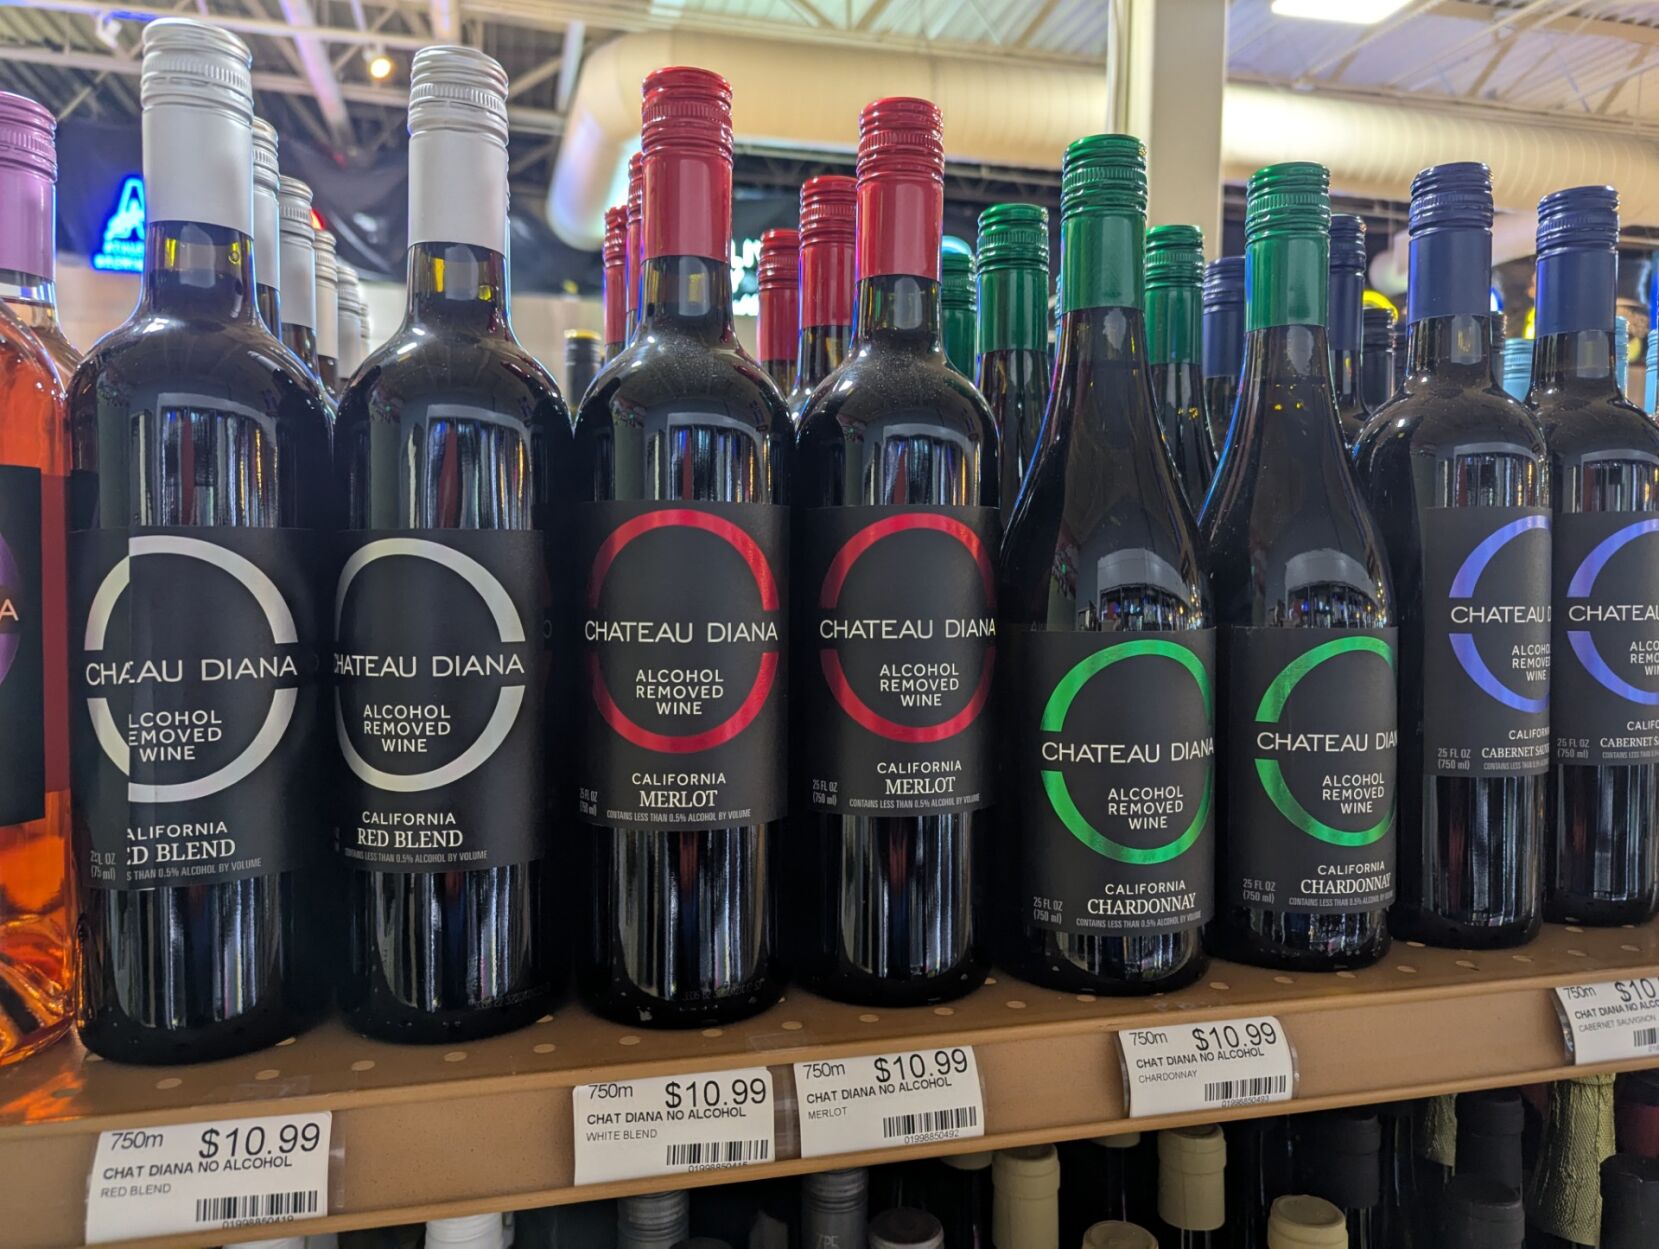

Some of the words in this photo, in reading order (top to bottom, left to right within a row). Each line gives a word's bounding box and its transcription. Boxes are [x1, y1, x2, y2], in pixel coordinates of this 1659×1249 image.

[1450, 606, 1544, 624] CHATEAU
[585, 620, 693, 643] CHATEAU
[707, 621, 778, 642] DIANA
[820, 619, 934, 639] CHATEAU
[945, 617, 996, 638] DIANA
[201, 656, 297, 681] DIANA
[432, 654, 524, 677] DIANA
[880, 663, 959, 676] ALCOHOL
[636, 669, 724, 683] ALCOHOL
[1526, 670, 1546, 681] WINE
[636, 685, 724, 699] REMOVED
[880, 678, 960, 692] REMOVED
[900, 694, 942, 706] WINE
[363, 704, 450, 720] ALCOHOL
[656, 701, 702, 716] WINE
[364, 721, 450, 736] REMOVED
[382, 738, 427, 752] WINE
[1256, 732, 1368, 752] CHATEAU
[1568, 738, 1578, 748] FL
[1579, 738, 1590, 748] OZ
[1600, 736, 1652, 748] CABERNET
[139, 745, 196, 762] WINE
[1042, 742, 1160, 763] CHATEAU
[1170, 737, 1214, 761] DIANA
[1438, 748, 1448, 758] 25
[1450, 748, 1458, 758] FL
[1460, 748, 1471, 759] OZ
[1482, 746, 1534, 758] CABERNET
[1557, 748, 1574, 758] (750
[877, 760, 962, 774] CALIFORNIA
[1438, 759, 1456, 769] (750
[632, 772, 726, 786] CALIFORNIA
[885, 776, 956, 796] MERLOT
[1322, 773, 1385, 786] ALCOHOL
[828, 782, 838, 793] OZ
[1108, 786, 1184, 800] ALCOHOL
[1322, 787, 1384, 801] REMOVED
[639, 790, 718, 808] MERLOT
[849, 798, 878, 808] CONTAINS
[880, 798, 895, 808] LESS
[896, 798, 913, 808] THAN
[914, 798, 930, 808] 0.5%
[607, 809, 633, 821] CONTAINS
[634, 811, 648, 822] LESS
[650, 812, 668, 822] THAN
[669, 812, 686, 822] 0.5%
[688, 810, 716, 822] ALCOHOL
[718, 810, 726, 821] BY
[728, 808, 751, 820] VOLUME
[1109, 800, 1183, 815] REMOVED
[1340, 801, 1373, 814] WINE
[362, 811, 456, 826] CALIFORNIA
[1128, 816, 1168, 830] WINE
[357, 828, 389, 846] RED
[394, 829, 464, 848] BLEND
[156, 838, 236, 864] BLEND
[378, 852, 395, 862] THAN
[396, 853, 413, 863] 0.5%
[415, 852, 445, 864] ALCOHOL
[448, 852, 458, 862] BY
[460, 850, 488, 861] VOLUME
[134, 868, 156, 881] THAN
[158, 867, 180, 879] 0.5%
[181, 862, 216, 877] ALCOHOL
[218, 862, 230, 873] BY
[231, 857, 262, 872] VOLUME
[1318, 860, 1385, 876] CALIFORNIA
[1104, 880, 1186, 895] CALIFORNIA
[1243, 878, 1252, 889] 25
[1254, 880, 1263, 890] FL
[1264, 881, 1276, 892] OZ
[1300, 872, 1392, 894] CHARDONNAY
[1033, 896, 1042, 908] 25
[1043, 898, 1052, 910] FL
[1053, 900, 1064, 912] OZ
[1087, 893, 1196, 915] CHARDONNAY
[1243, 890, 1260, 902] (750
[1262, 892, 1275, 904] ml)
[1033, 909, 1048, 922] (750
[1050, 912, 1062, 925] ml)
[1076, 918, 1106, 928] CONTAINS
[1107, 918, 1122, 928] LESS
[1124, 918, 1140, 928] THAN
[1141, 918, 1156, 928] 0.5%
[1563, 986, 1597, 1000] 750m
[1574, 1008, 1598, 1020] CHAT
[1599, 1004, 1625, 1016] DIANA
[1626, 1002, 1638, 1012] NO
[1578, 1020, 1615, 1032] CABERNET
[1129, 1030, 1168, 1046] 750m
[1192, 1022, 1276, 1051] $10.99
[1136, 1056, 1164, 1068] CHAT
[1167, 1054, 1198, 1066] DIANA
[1200, 1052, 1214, 1062] NO
[1218, 1047, 1264, 1060] ALCOHOL
[803, 1062, 846, 1080] 750m
[874, 1048, 968, 1083] $10.99
[1138, 1070, 1198, 1084] CHARDONNAY
[588, 1084, 633, 1100] 750m
[665, 1078, 766, 1108] $10.99
[806, 1091, 838, 1104] CHAT
[842, 1086, 876, 1100] DIANA
[879, 1084, 895, 1094] NO
[900, 1077, 952, 1092] ALCOHOL
[587, 1113, 620, 1125] CHAT
[625, 1110, 663, 1123] DIANA
[666, 1110, 684, 1121] NO
[688, 1106, 746, 1120] ALCOHOL
[808, 1106, 848, 1120] MERLOT
[111, 1131, 164, 1150] 750m
[198, 1122, 320, 1158] $10.99
[586, 1130, 620, 1142] WHITE
[624, 1128, 658, 1140] BLEND
[103, 1165, 144, 1180] CHAT
[149, 1162, 193, 1177] DIANA
[198, 1160, 220, 1173] NO
[224, 1156, 292, 1170] ALCOHOL
[100, 1186, 127, 1198] RED
[130, 1184, 171, 1195] BLEND
